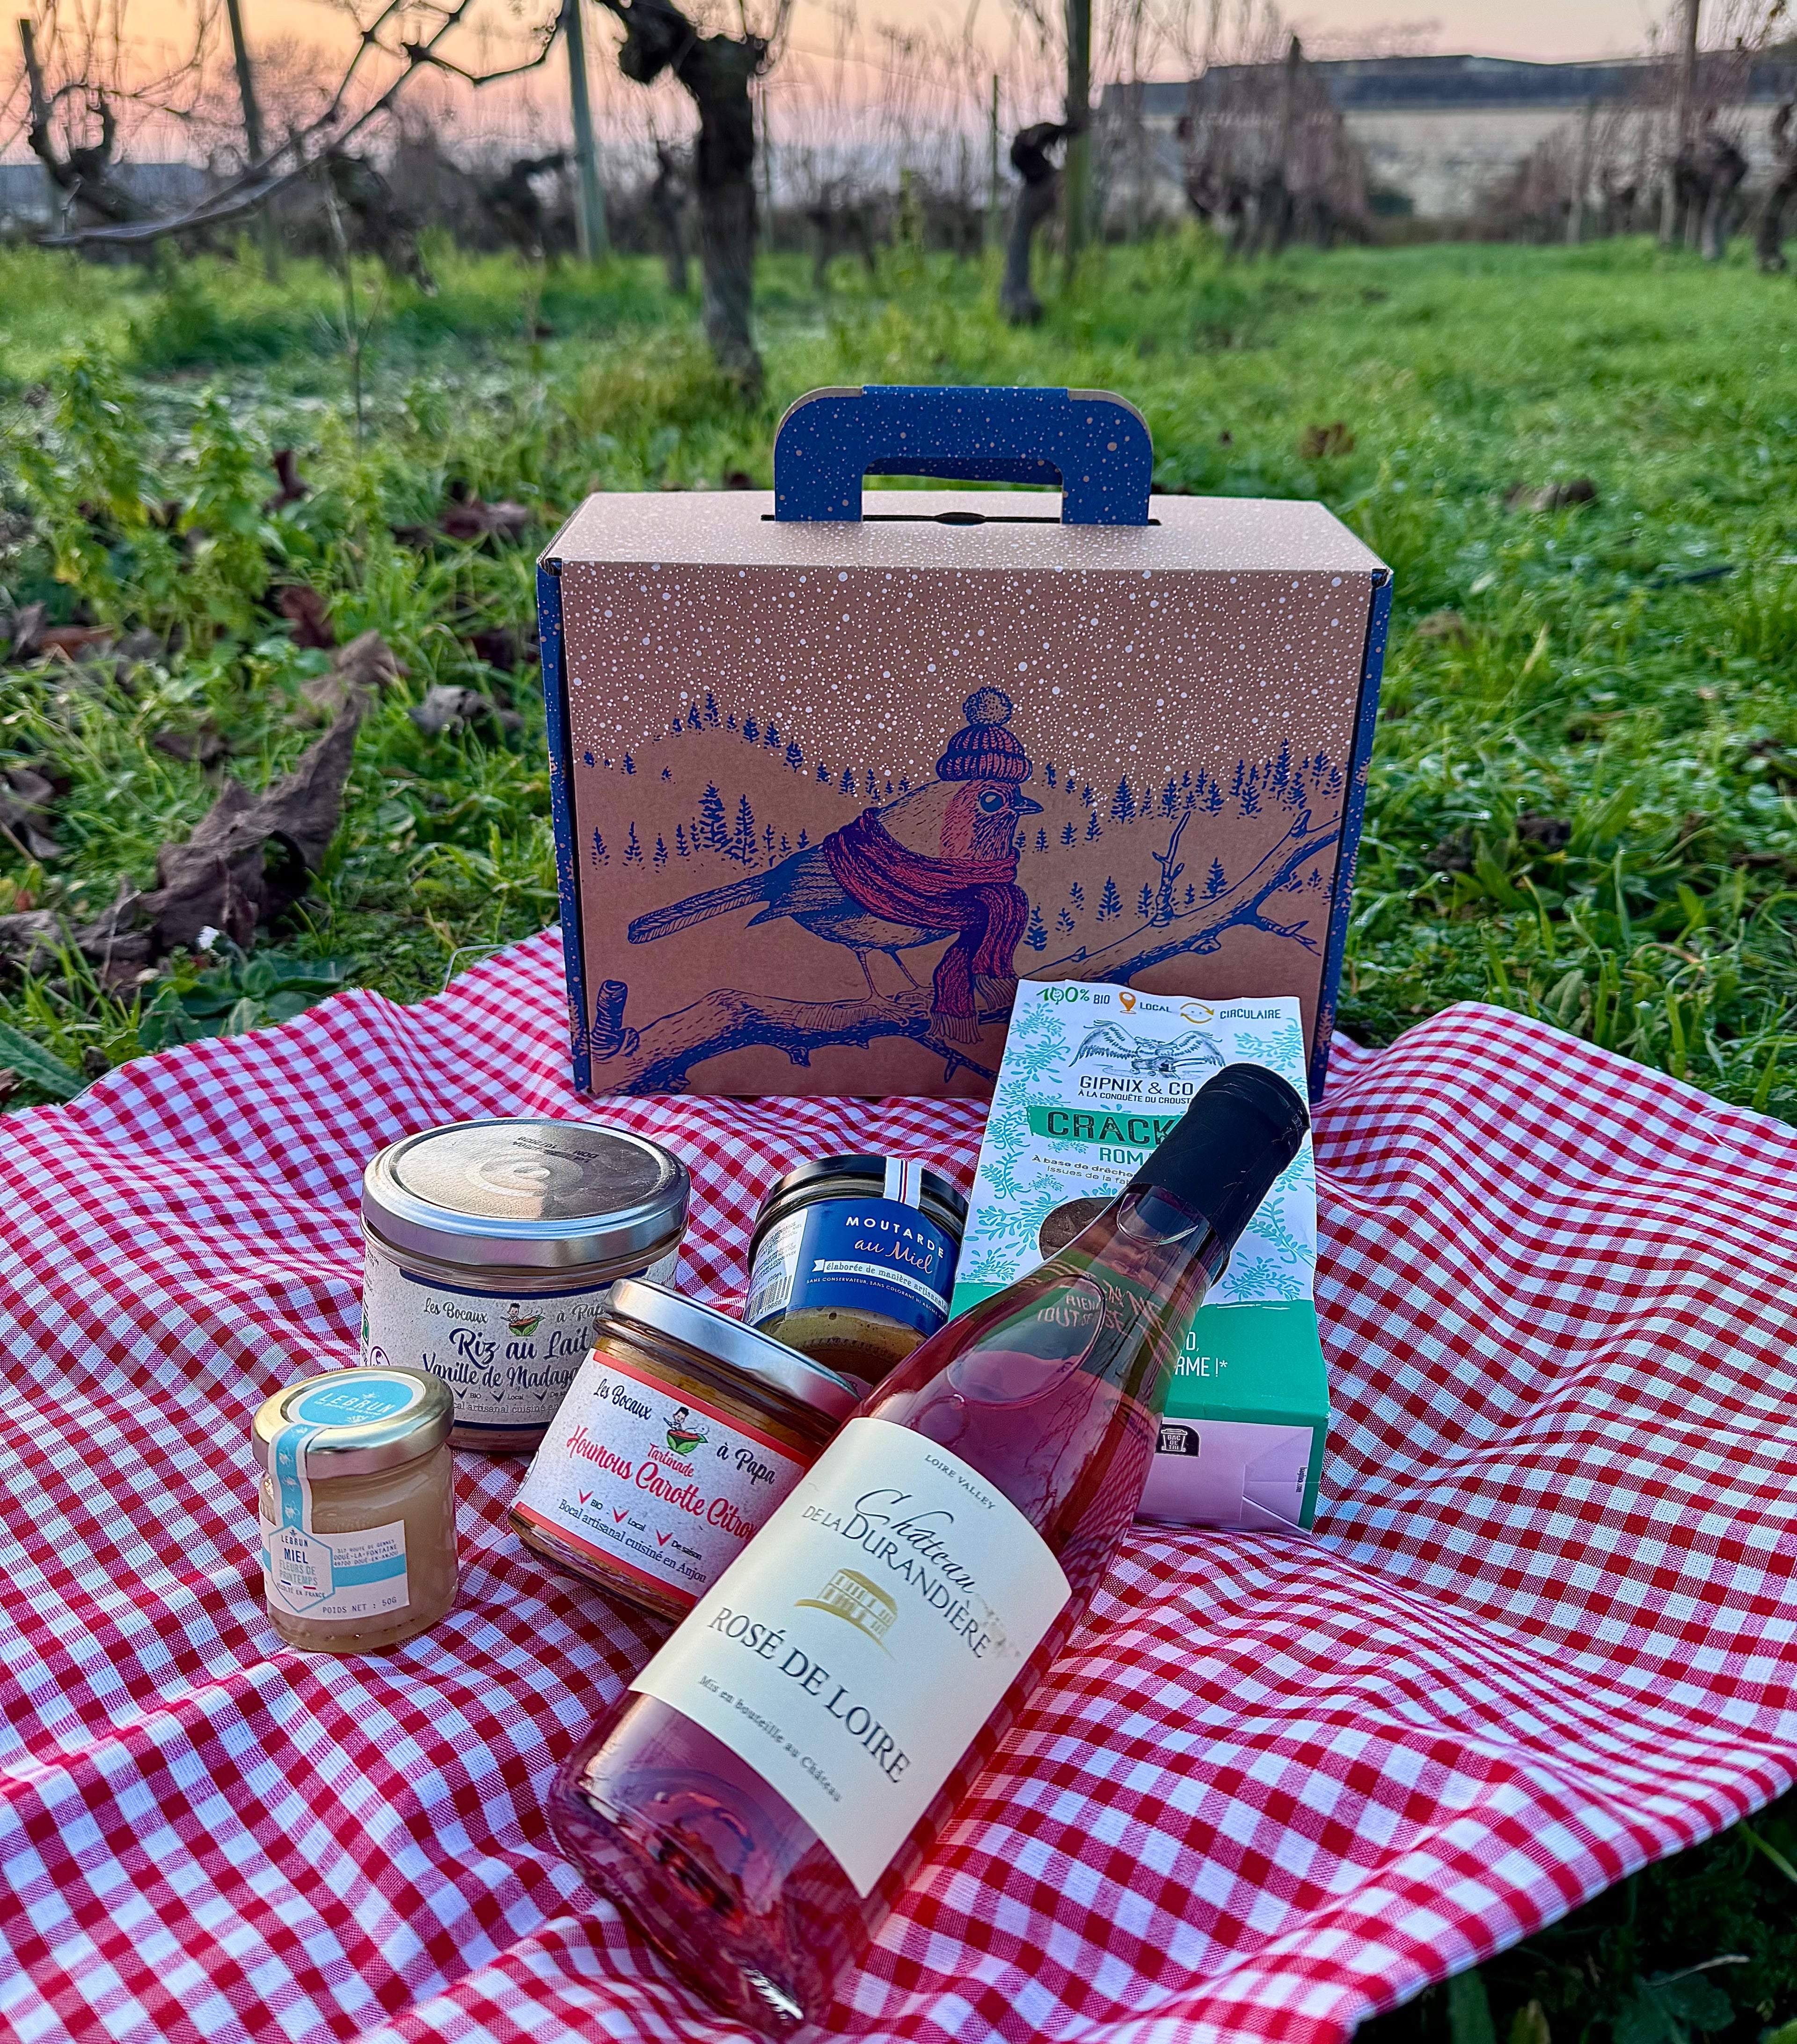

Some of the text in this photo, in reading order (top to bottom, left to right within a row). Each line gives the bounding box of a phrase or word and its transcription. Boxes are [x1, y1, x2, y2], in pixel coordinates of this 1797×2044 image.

[1094, 994, 1110, 1004] BIO
[1140, 1002, 1172, 1013] LOCAL
[1220, 1009, 1281, 1019] CIRCULAIRE
[1080, 1076, 1194, 1096] GIPNIX & CO
[1100, 1092, 1143, 1102] CONQUÊTE
[1047, 1111, 1176, 1145] CRACK
[1099, 1147, 1150, 1165] ROM
[1043, 1157, 1072, 1167] base
[1091, 1165, 1135, 1178] drêche
[846, 1216, 944, 1258] MOUTARDE
[855, 1240, 933, 1274] au Miel
[826, 1262, 947, 1310] élaborée de manière artisanale
[886, 1285, 915, 1300] COLORANT
[423, 1297, 606, 1324] Les Bocaux à Pap
[449, 1325, 592, 1370] Riz au Lait
[422, 1351, 580, 1390] Vanille de Madaga
[319, 1392, 396, 1414] LEBRUN
[468, 1403, 509, 1413] artisanal
[512, 1402, 546, 1413] cuisiné
[593, 1378, 776, 1485] Les Bocaux à Papa
[647, 1442, 695, 1477] Tartinade
[567, 1425, 633, 1480] Houmous
[635, 1461, 705, 1517] Carotte
[925, 1454, 996, 1510] LOIRE VALLEY
[590, 1498, 603, 1511] BIO
[628, 1517, 646, 1532] Local
[281, 1534, 308, 1547] LEBRUN
[558, 1498, 707, 1583] Bocal artisanal cuisiné en Anjou
[671, 1540, 702, 1561] De saison
[855, 1489, 976, 1593] Château
[284, 1547, 309, 1564] MIEL
[279, 1559, 316, 1575] FLEURS DE
[802, 1505, 991, 1658] DE LA DURANDIÈRE
[352, 1603, 367, 1612] NET
[382, 1597, 397, 1607] 50G
[707, 1607, 912, 1783] ROSÉ DE LOIRE
[699, 1675, 842, 1803] Mis en bouteille au Château
